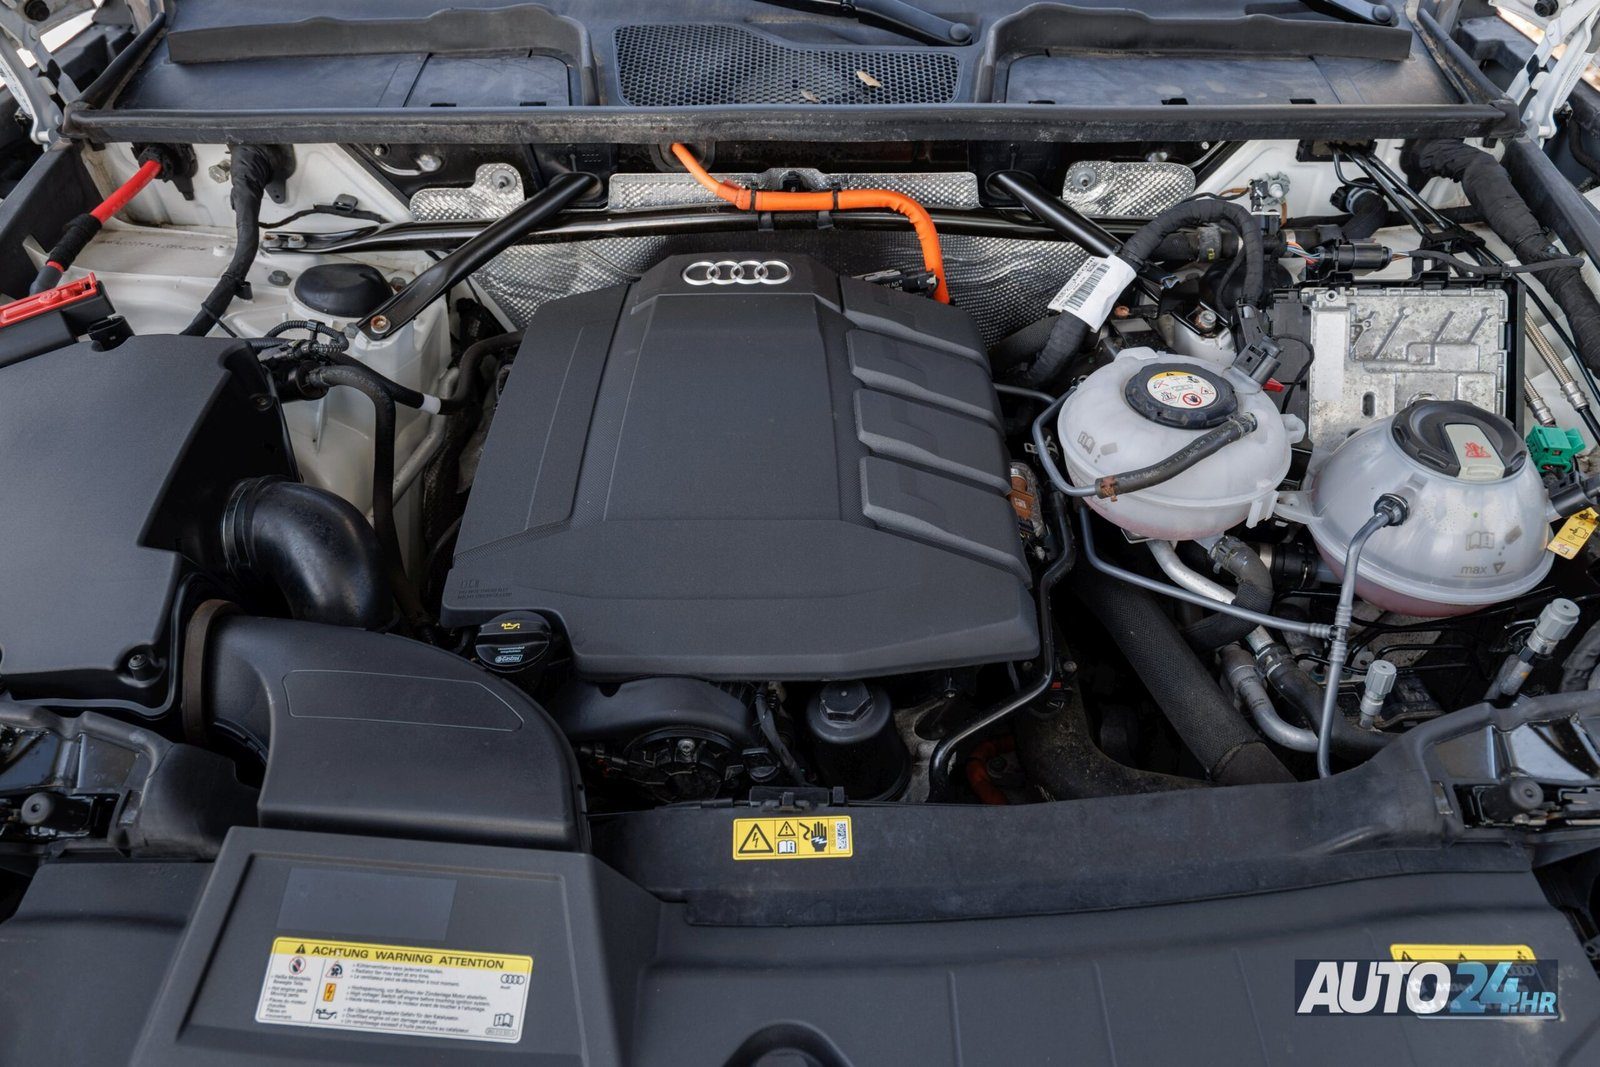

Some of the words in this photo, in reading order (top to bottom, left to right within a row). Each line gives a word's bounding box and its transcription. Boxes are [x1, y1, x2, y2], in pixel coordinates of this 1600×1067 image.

[1461, 566, 1487, 574] max
[312, 946, 369, 959] ACHTUNG
[375, 951, 433, 964] WARNING
[439, 956, 504, 969] ATTENTION
